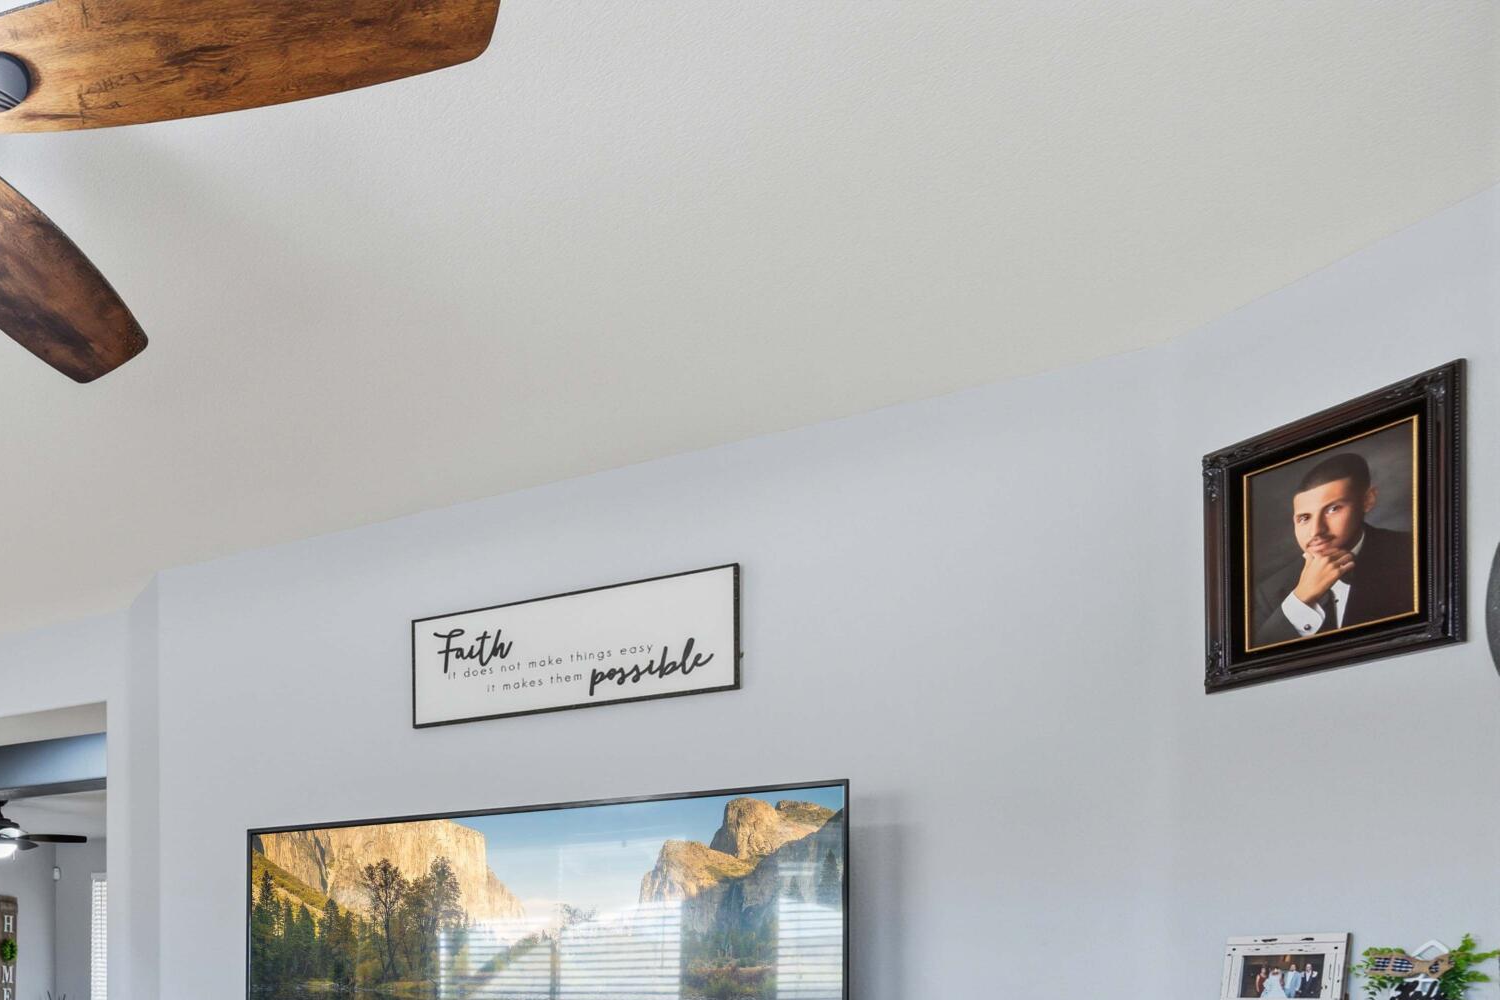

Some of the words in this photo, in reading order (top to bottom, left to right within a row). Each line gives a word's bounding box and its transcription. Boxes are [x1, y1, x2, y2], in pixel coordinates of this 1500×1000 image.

[433, 628, 513, 674] Faith
[447, 671, 456, 680] it
[463, 667, 494, 679] does
[500, 661, 521, 673] not
[528, 655, 563, 669] make
[570, 650, 612, 661] things
[620, 643, 653, 655] easy
[486, 684, 495, 693] it
[502, 678, 544, 692] makes
[550, 673, 583, 685] them
[589, 637, 715, 697] possible
